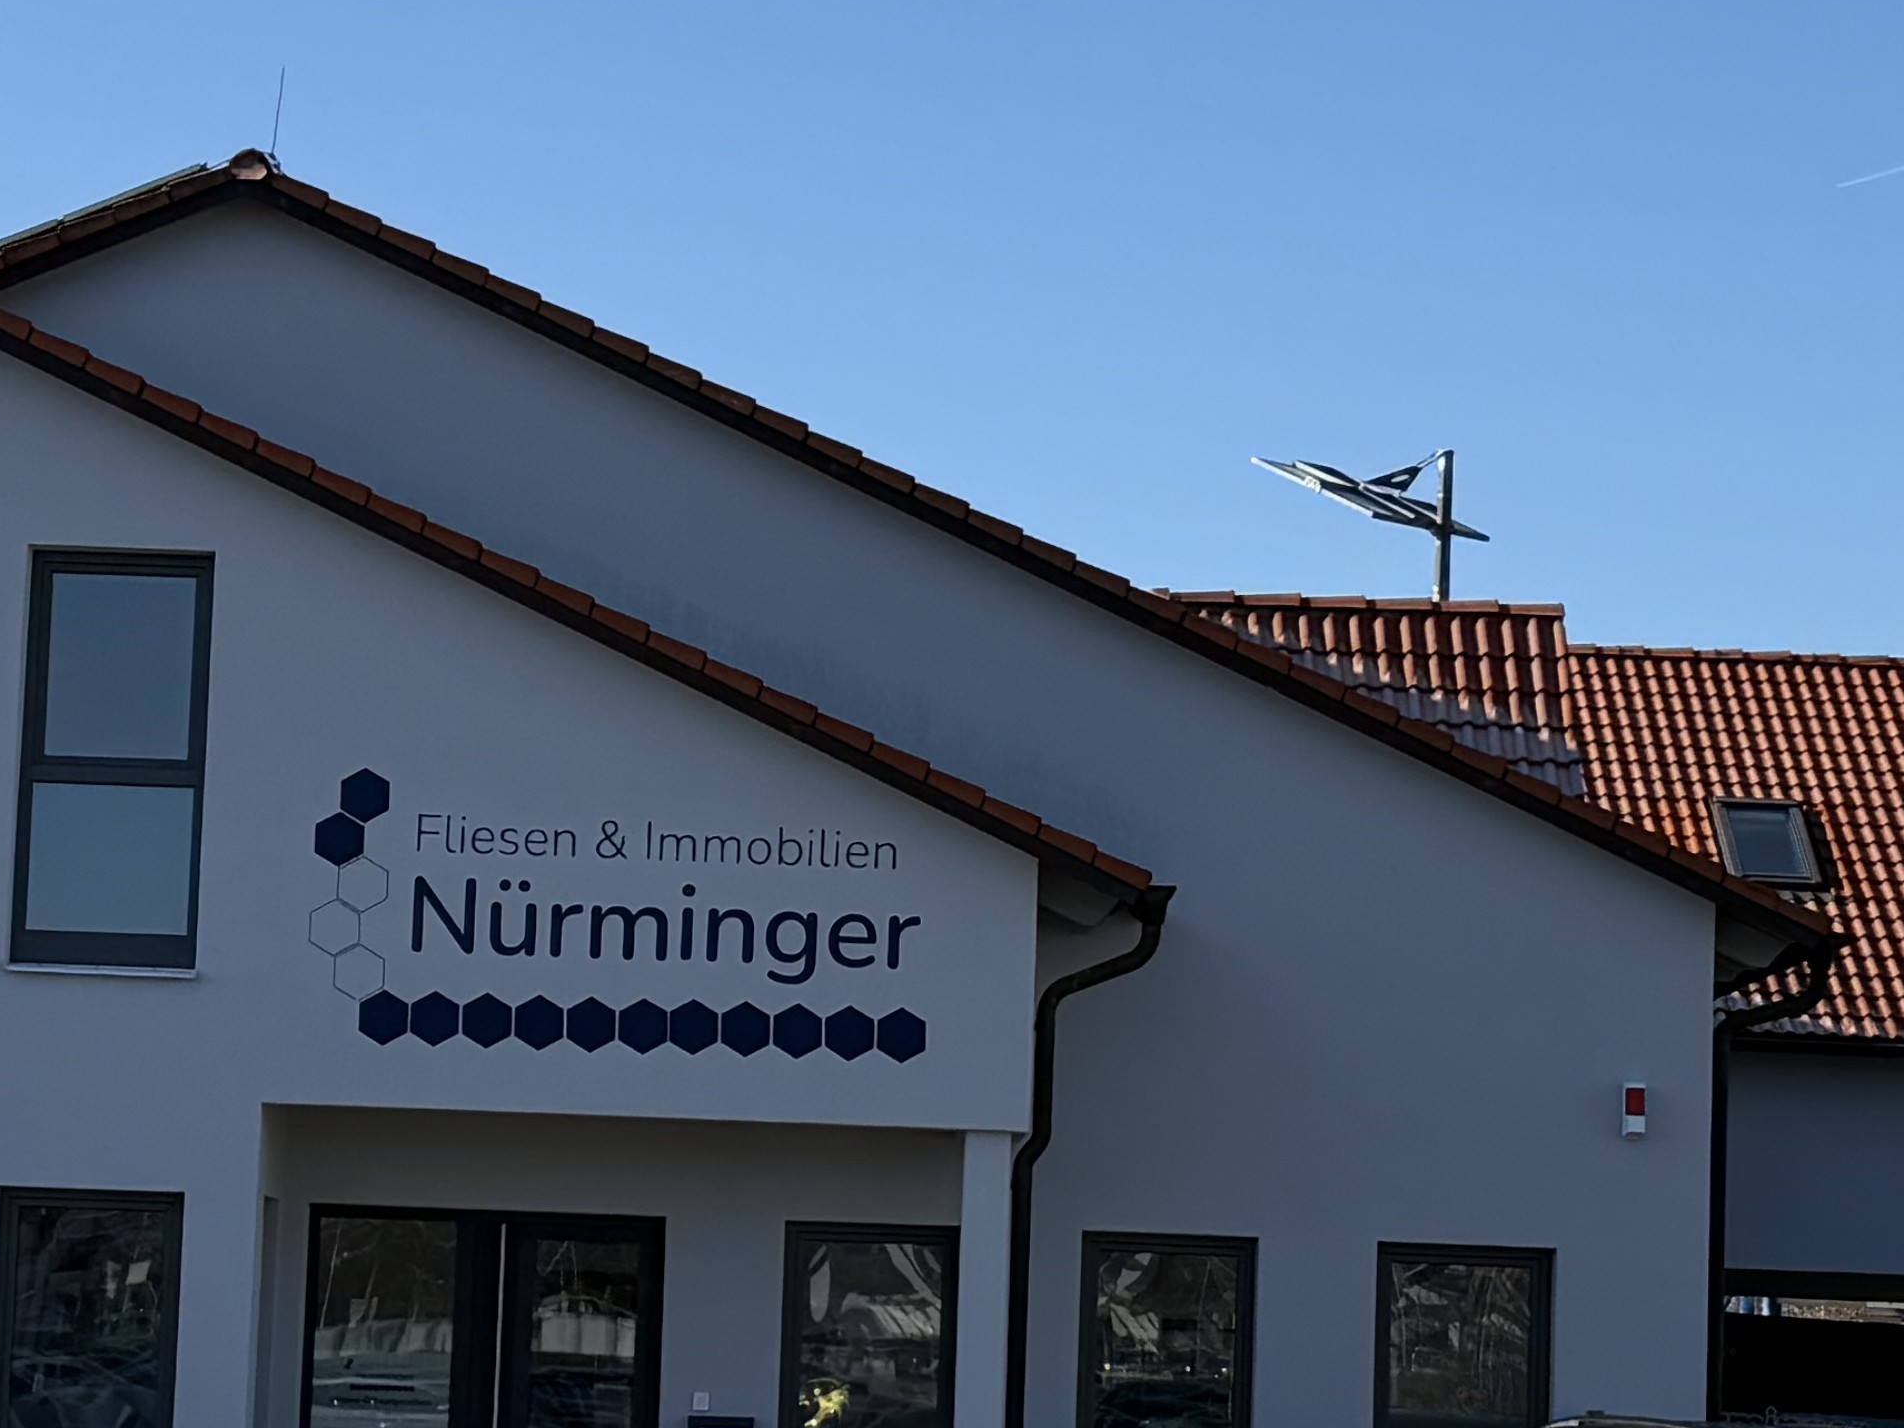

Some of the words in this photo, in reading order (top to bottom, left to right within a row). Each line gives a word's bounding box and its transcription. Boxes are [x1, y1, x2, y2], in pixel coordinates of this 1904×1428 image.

[415, 813, 577, 859] Fliesen
[595, 819, 628, 860] &
[646, 820, 898, 870] Immobilien
[410, 875, 922, 985] Nürminger
